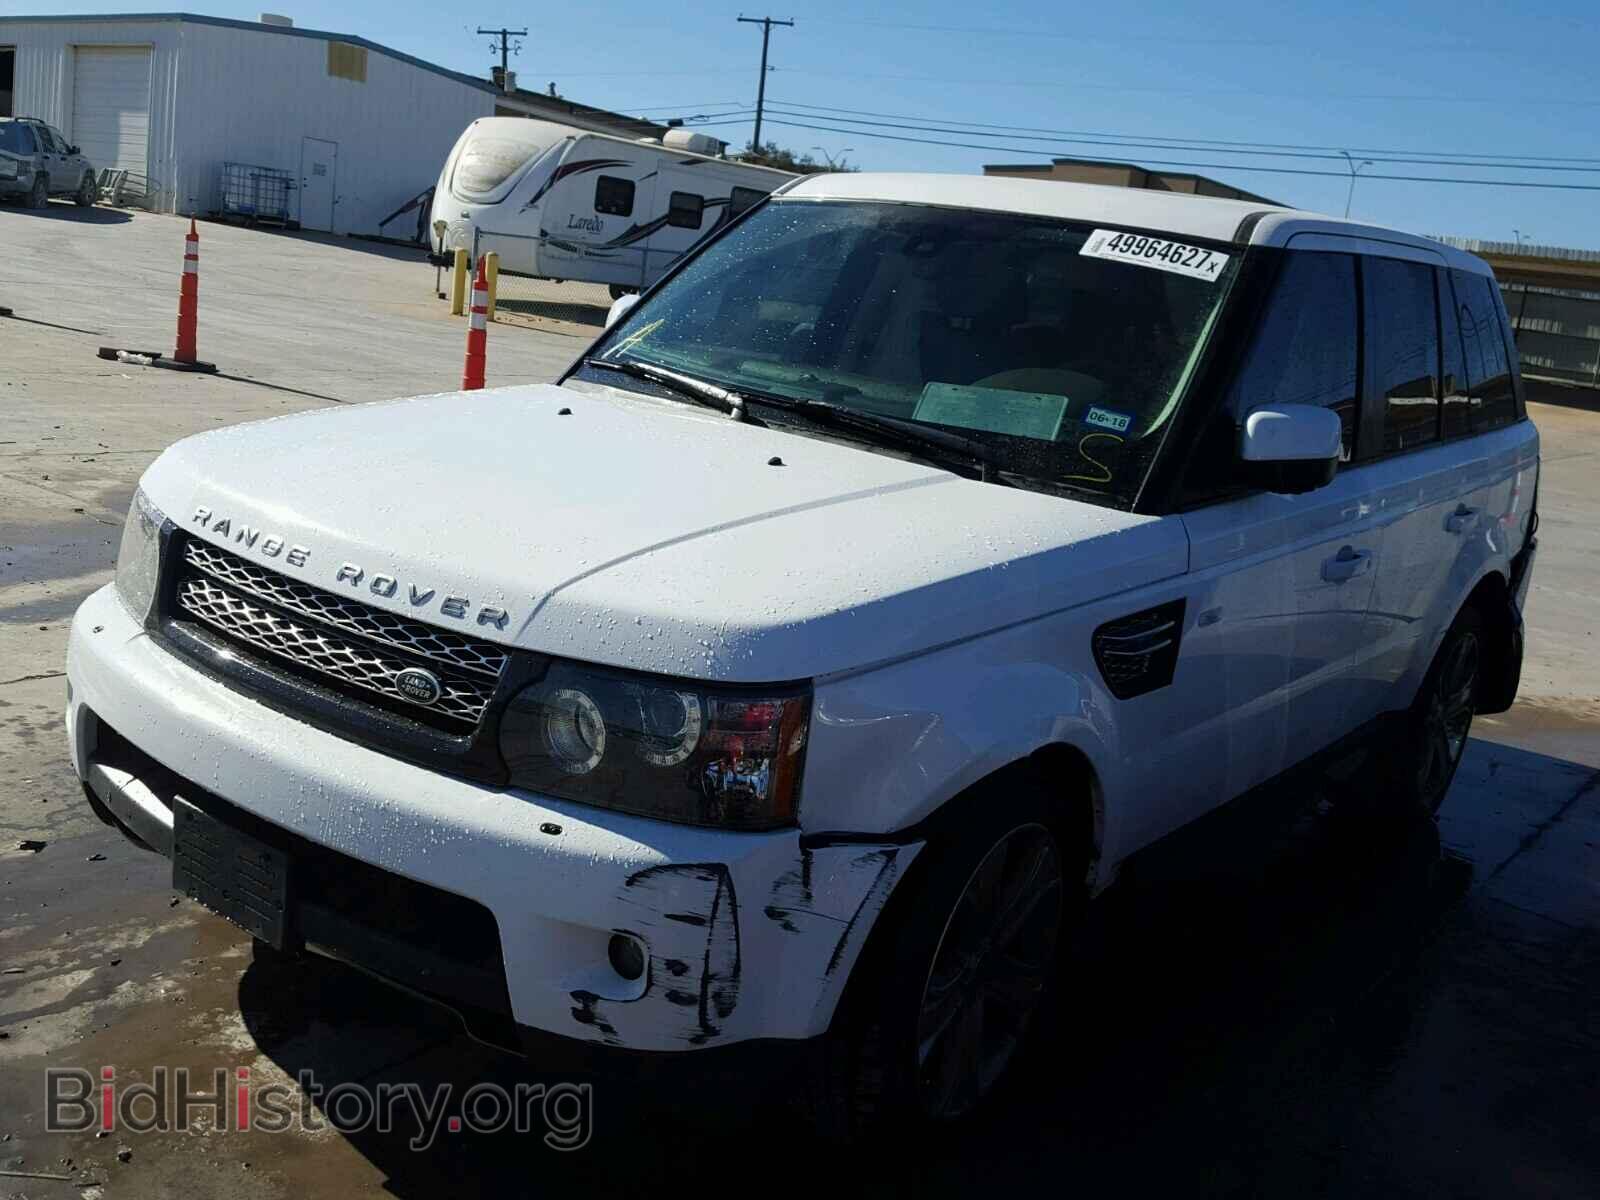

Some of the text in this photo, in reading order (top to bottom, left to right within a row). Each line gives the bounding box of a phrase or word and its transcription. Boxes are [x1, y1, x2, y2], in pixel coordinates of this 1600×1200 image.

[567, 213, 604, 234] Laredo
[1107, 234, 1212, 269] 49964627
[192, 504, 510, 631] RANGE ROVER
[404, 675, 426, 689] LAND
[405, 684, 431, 699] ROVER
